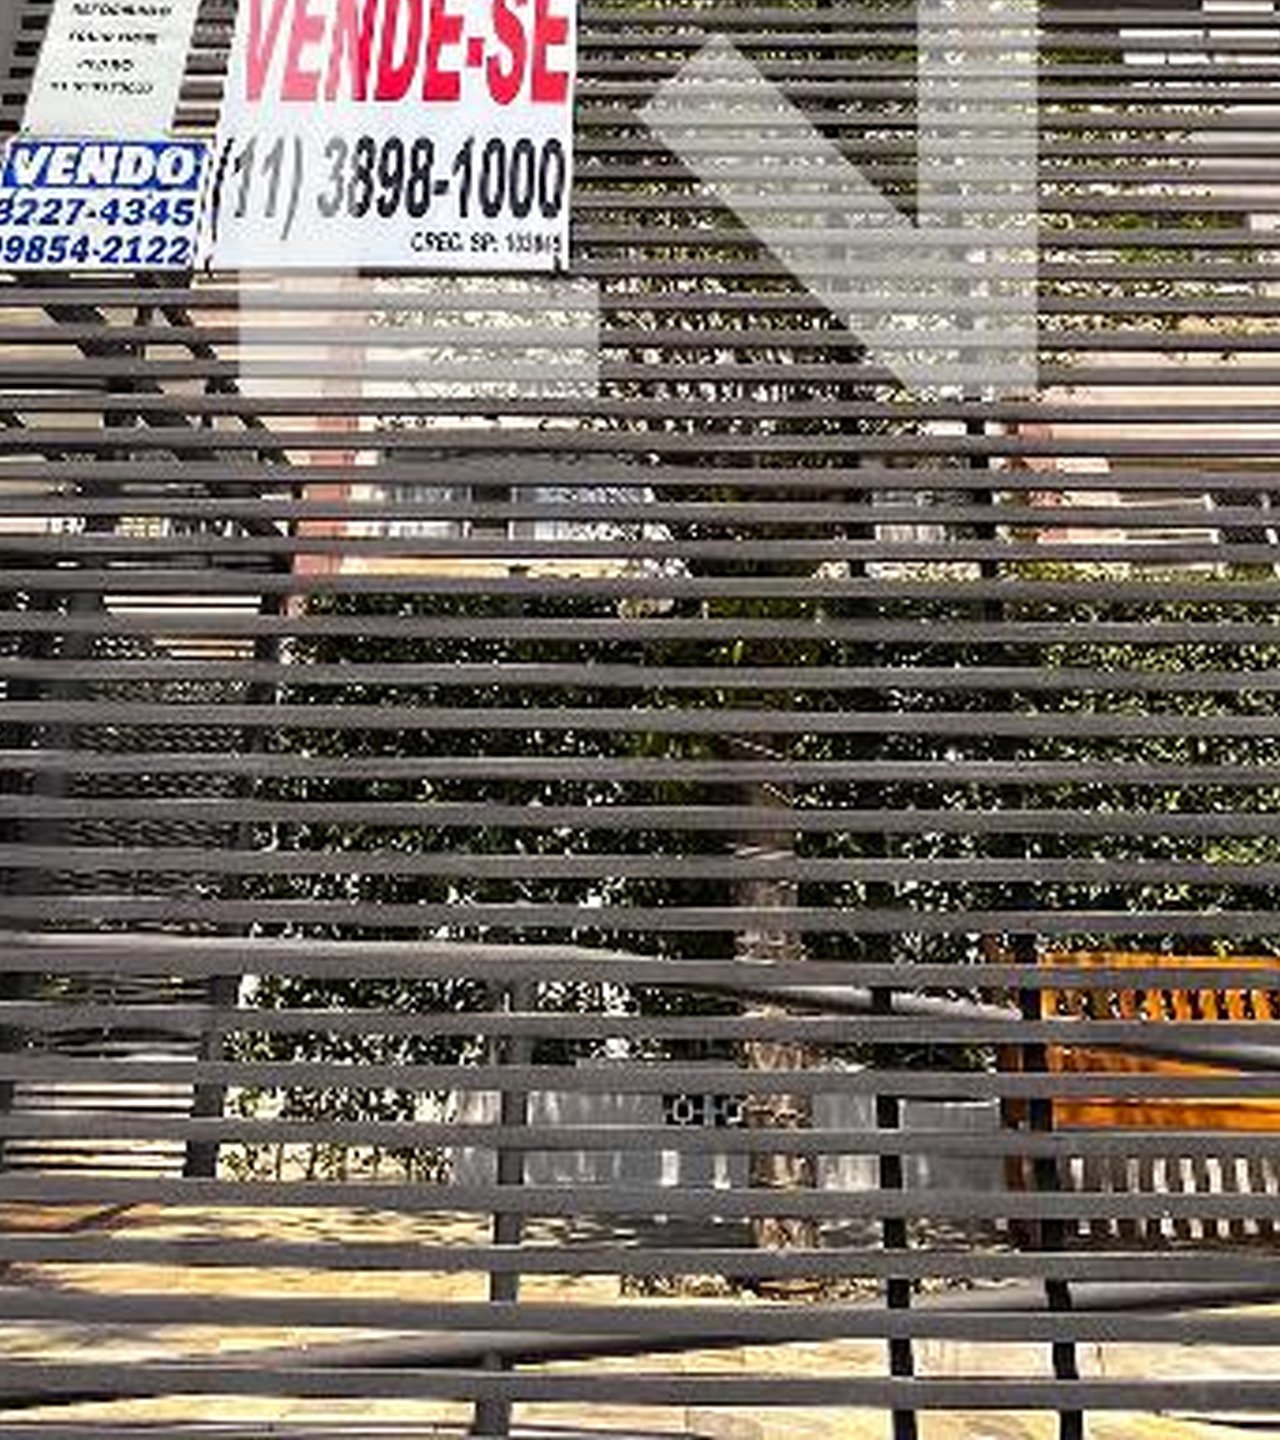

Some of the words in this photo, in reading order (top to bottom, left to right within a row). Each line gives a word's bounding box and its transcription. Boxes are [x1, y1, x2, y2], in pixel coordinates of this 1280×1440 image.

[14, 144, 196, 186] VENDO
[211, 135, 302, 241] (11)
[317, 135, 566, 219] 3898-1000
